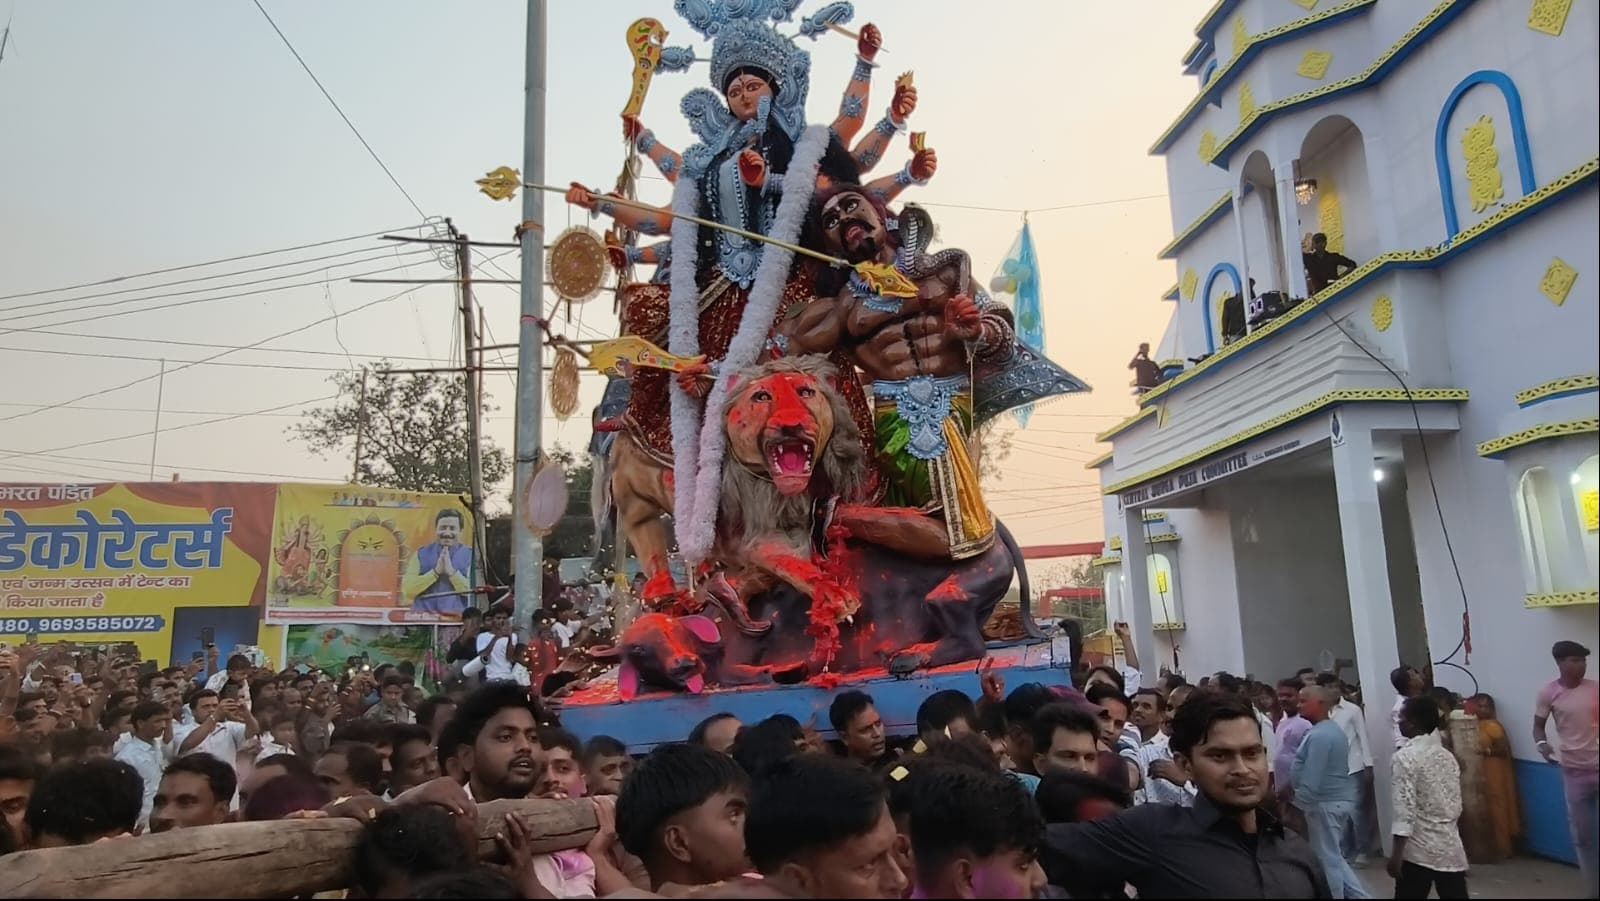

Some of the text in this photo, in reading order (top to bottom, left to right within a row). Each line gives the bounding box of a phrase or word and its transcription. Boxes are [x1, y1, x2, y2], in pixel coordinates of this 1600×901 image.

[1201, 451, 1248, 481] COMMITTEE
[0, 508, 233, 571] डेकोरेटर्स
[2, 575, 190, 590] एवं जन्म उत्सव में टेन्ट का
[6, 593, 104, 608] किया जाता है
[39, 616, 156, 632] 9693585072
